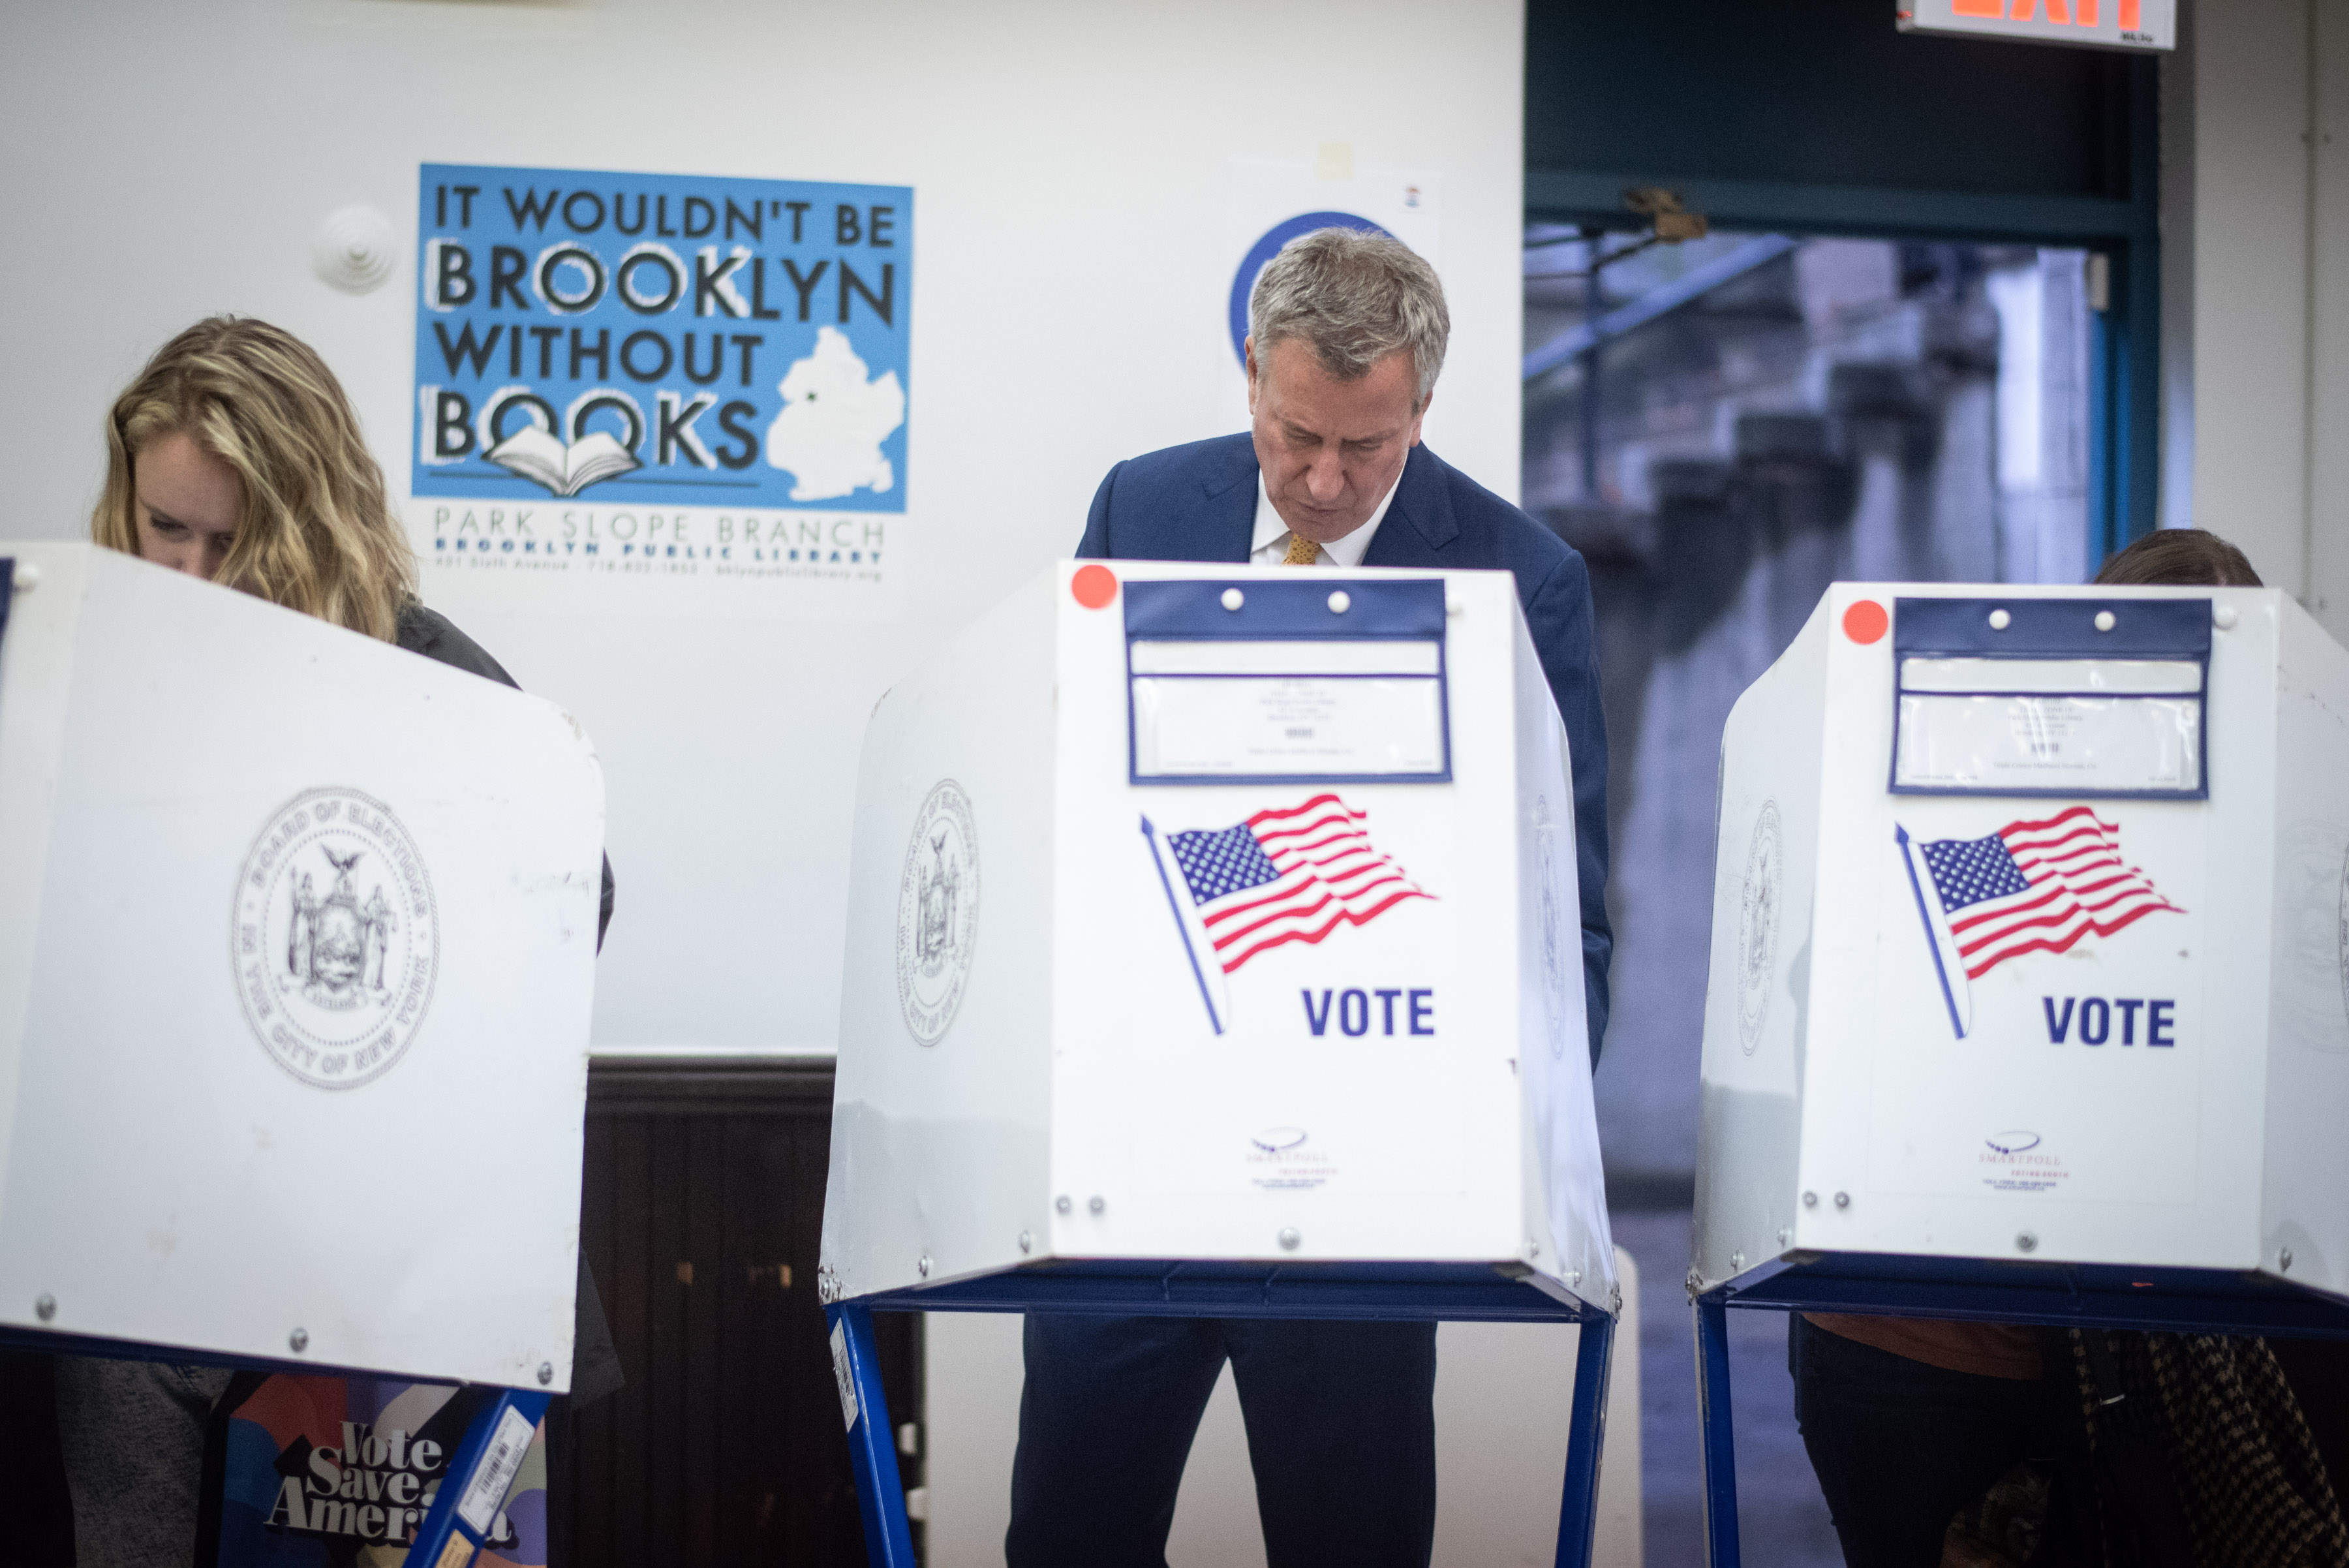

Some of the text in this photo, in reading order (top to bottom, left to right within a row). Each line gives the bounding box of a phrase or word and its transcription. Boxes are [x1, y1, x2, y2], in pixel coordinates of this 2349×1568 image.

[435, 185, 895, 247] IT WOULDN'T BE
[436, 243, 895, 328] BROOKLYN
[433, 319, 764, 387] WITHOUT
[435, 391, 760, 470] BOOKS
[435, 506, 883, 547] PARK SLOPE BRANCH
[436, 537, 881, 564] BROOKLYN PUBLIC LIBRARY
[470, 557, 507, 570] Sixth
[514, 559, 569, 570] Avenue
[251, 800, 429, 919] BOARD OF ELECTIONS
[271, 1022, 318, 1068] CITY
[322, 1054, 349, 1075] OF
[354, 1024, 397, 1071] NEW
[395, 953, 429, 1025] YORK
[1300, 988, 1435, 1036] VOTE
[2041, 996, 2175, 1048] VOTE
[1978, 1154, 2061, 1165] SMARTPOLL
[339, 1420, 444, 1472] Vote
[305, 1446, 421, 1505] Save
